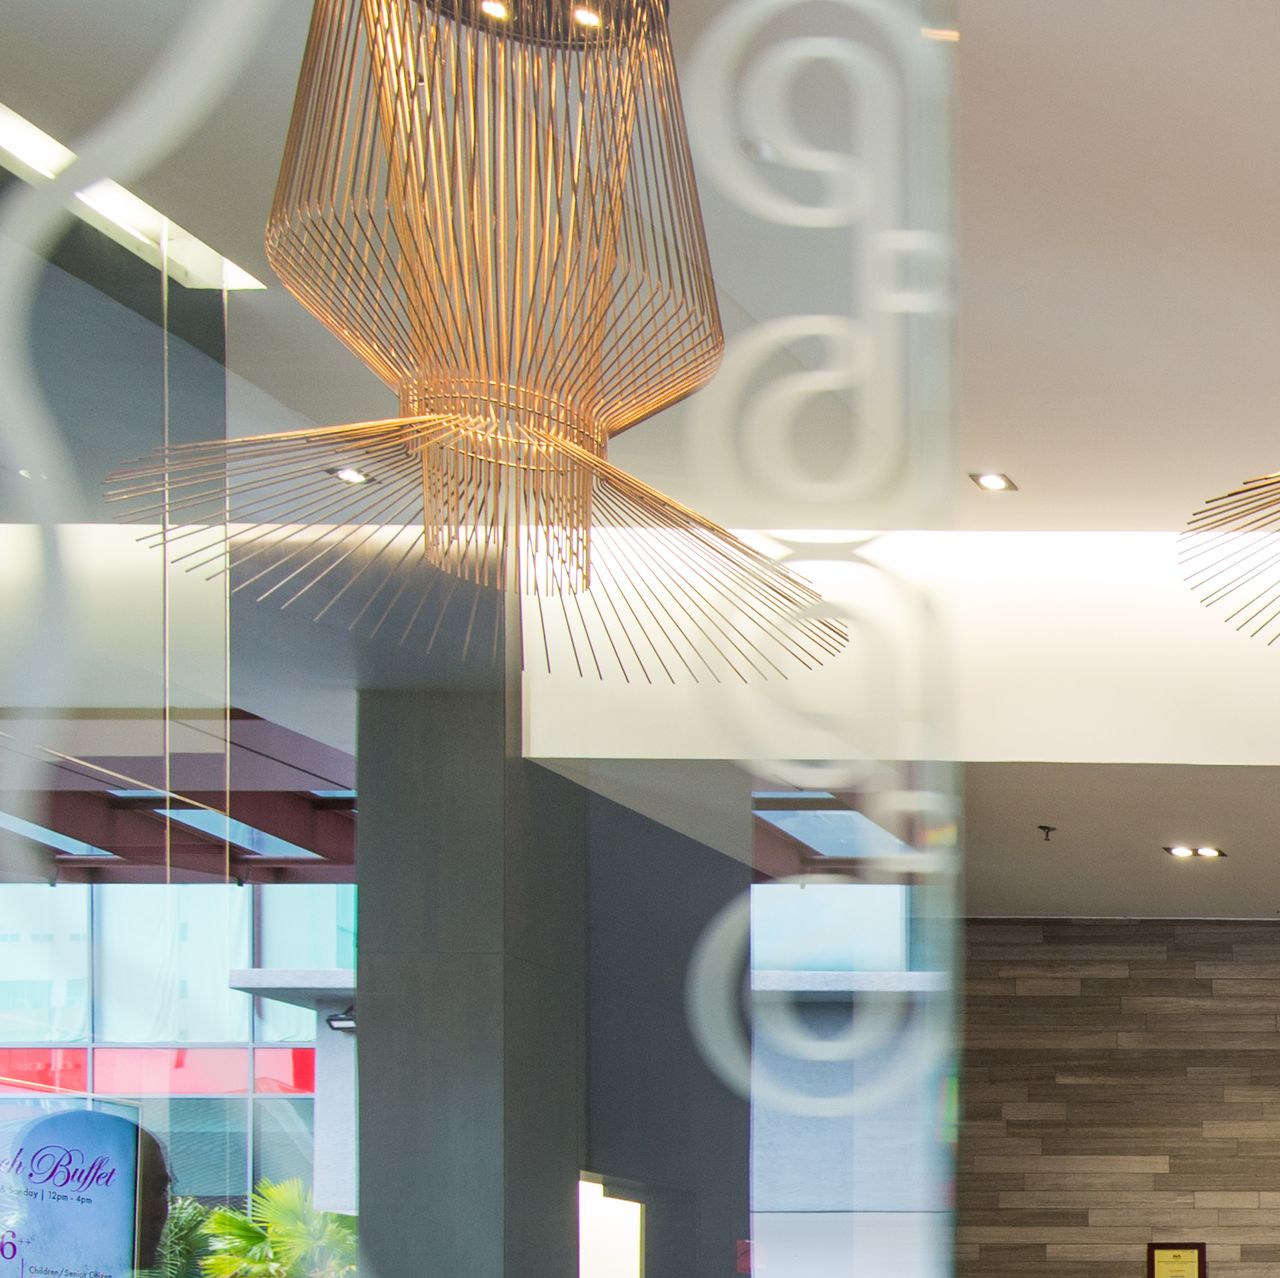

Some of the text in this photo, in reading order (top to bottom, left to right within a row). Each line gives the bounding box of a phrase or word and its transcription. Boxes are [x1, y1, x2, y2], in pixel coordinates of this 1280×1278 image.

[28, 1145, 117, 1193] Buffet
[48, 1190, 69, 1203] 12pm
[76, 1195, 93, 1205] 4pm
[28, 1265, 87, 1278] Children/Senior
